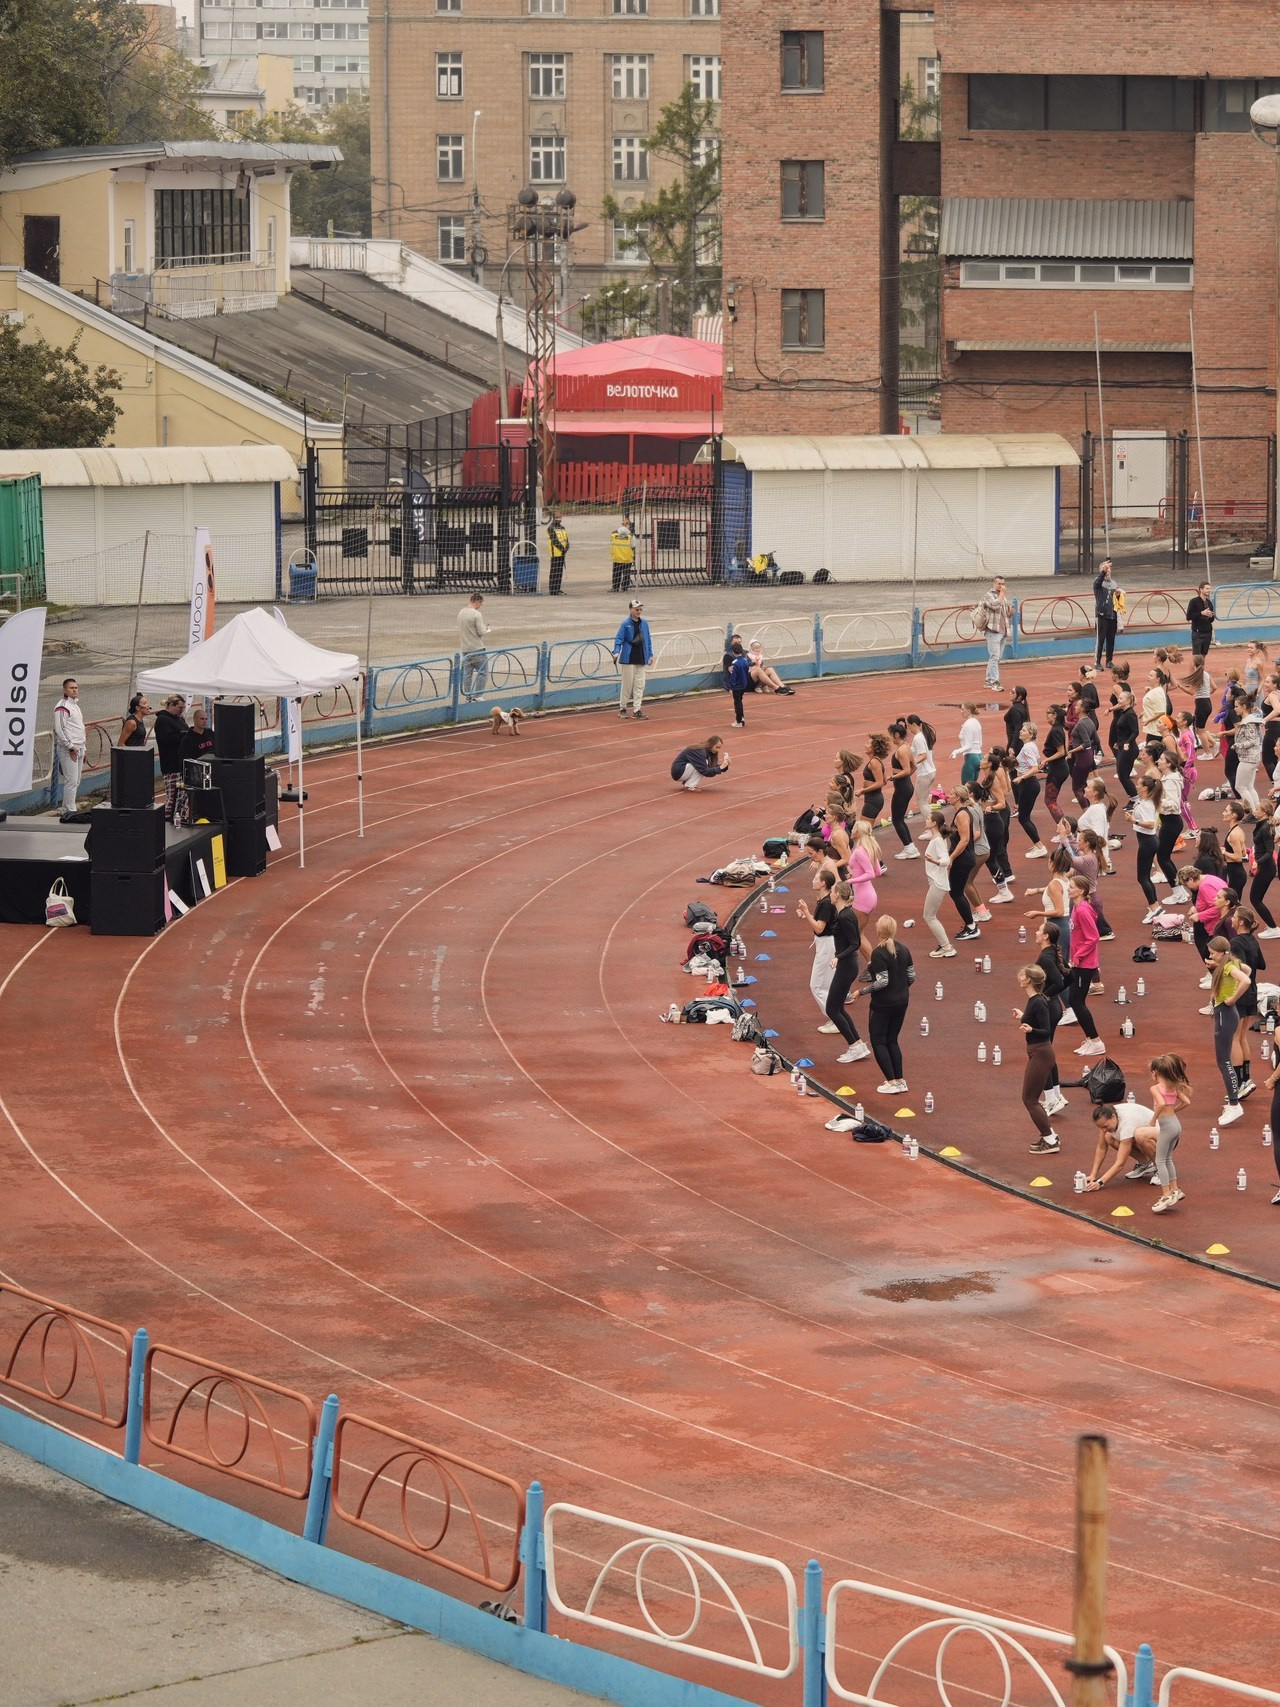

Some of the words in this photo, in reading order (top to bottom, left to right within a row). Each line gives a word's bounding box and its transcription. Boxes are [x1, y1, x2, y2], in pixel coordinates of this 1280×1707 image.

[3, 663, 28, 756] kolsa
[1225, 1060, 1234, 1075] PINK
[1230, 1076, 1238, 1094] SODA
